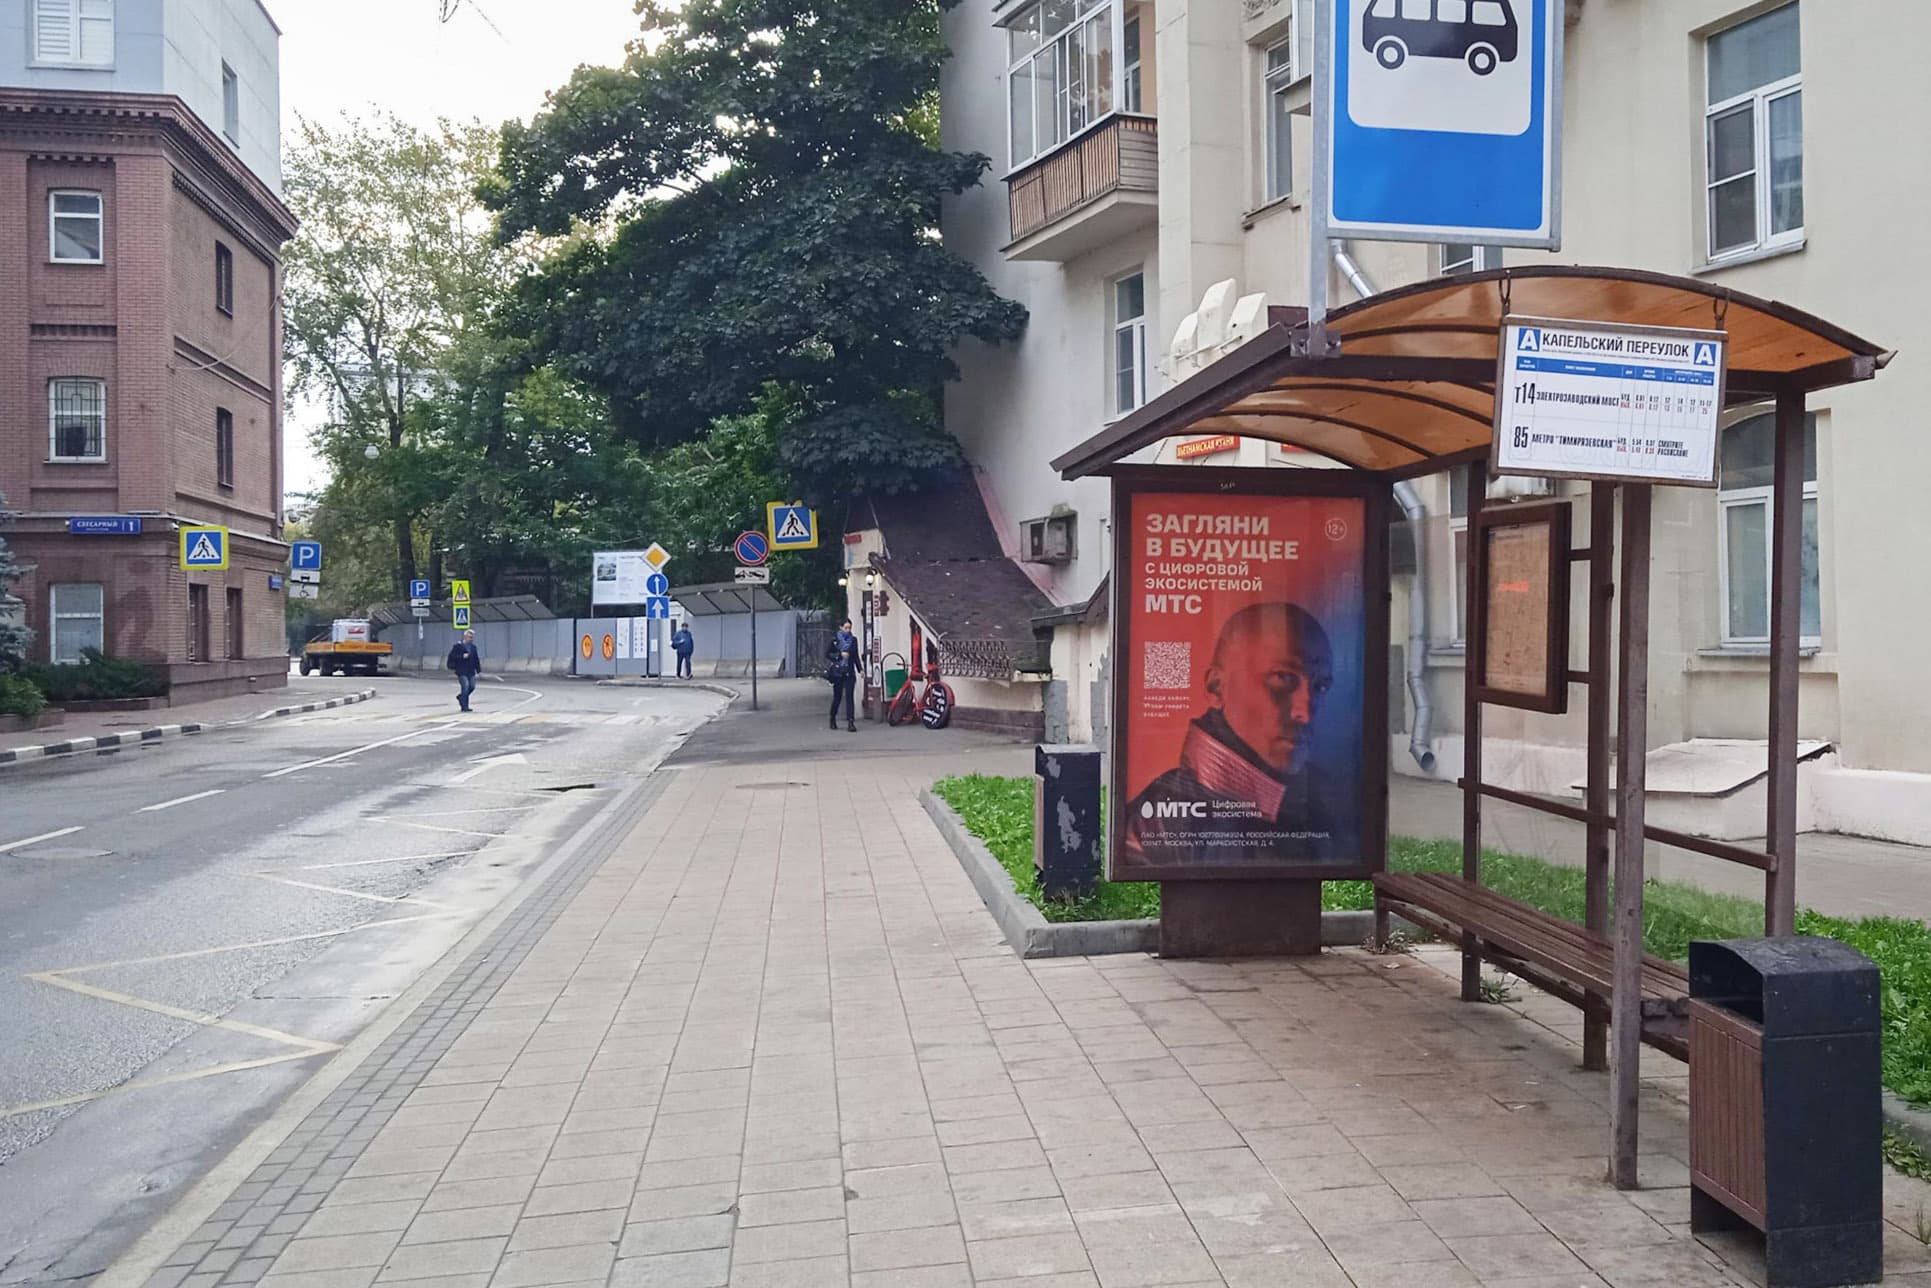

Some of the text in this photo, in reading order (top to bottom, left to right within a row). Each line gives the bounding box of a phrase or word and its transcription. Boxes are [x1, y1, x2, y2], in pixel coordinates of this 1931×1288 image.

[1542, 332, 1623, 352] КАПЕЛЬСКИЙ
[1626, 340, 1690, 358] ПЕРЕУЛОК
[1536, 391, 1600, 407] ЭЛЕКТРОЗАВОДСКИЙ
[1601, 396, 1620, 406] МОСТ
[1514, 426, 1528, 448] 85
[1532, 433, 1554, 444] МЕТРО
[128, 521, 134, 532] 1
[1146, 513, 1270, 536] ЗАГЛЯНИ
[298, 546, 314, 566] P
[1146, 538, 1299, 562] В БУДУЩЕЕ
[1145, 561, 1249, 577] С ЦИФРОВОЙ
[416, 582, 426, 596] P
[1144, 576, 1262, 592] ЭКОСИСТЕМОЙ
[1145, 594, 1202, 614] МТС
[1156, 800, 1257, 818] МТС Цифровая
